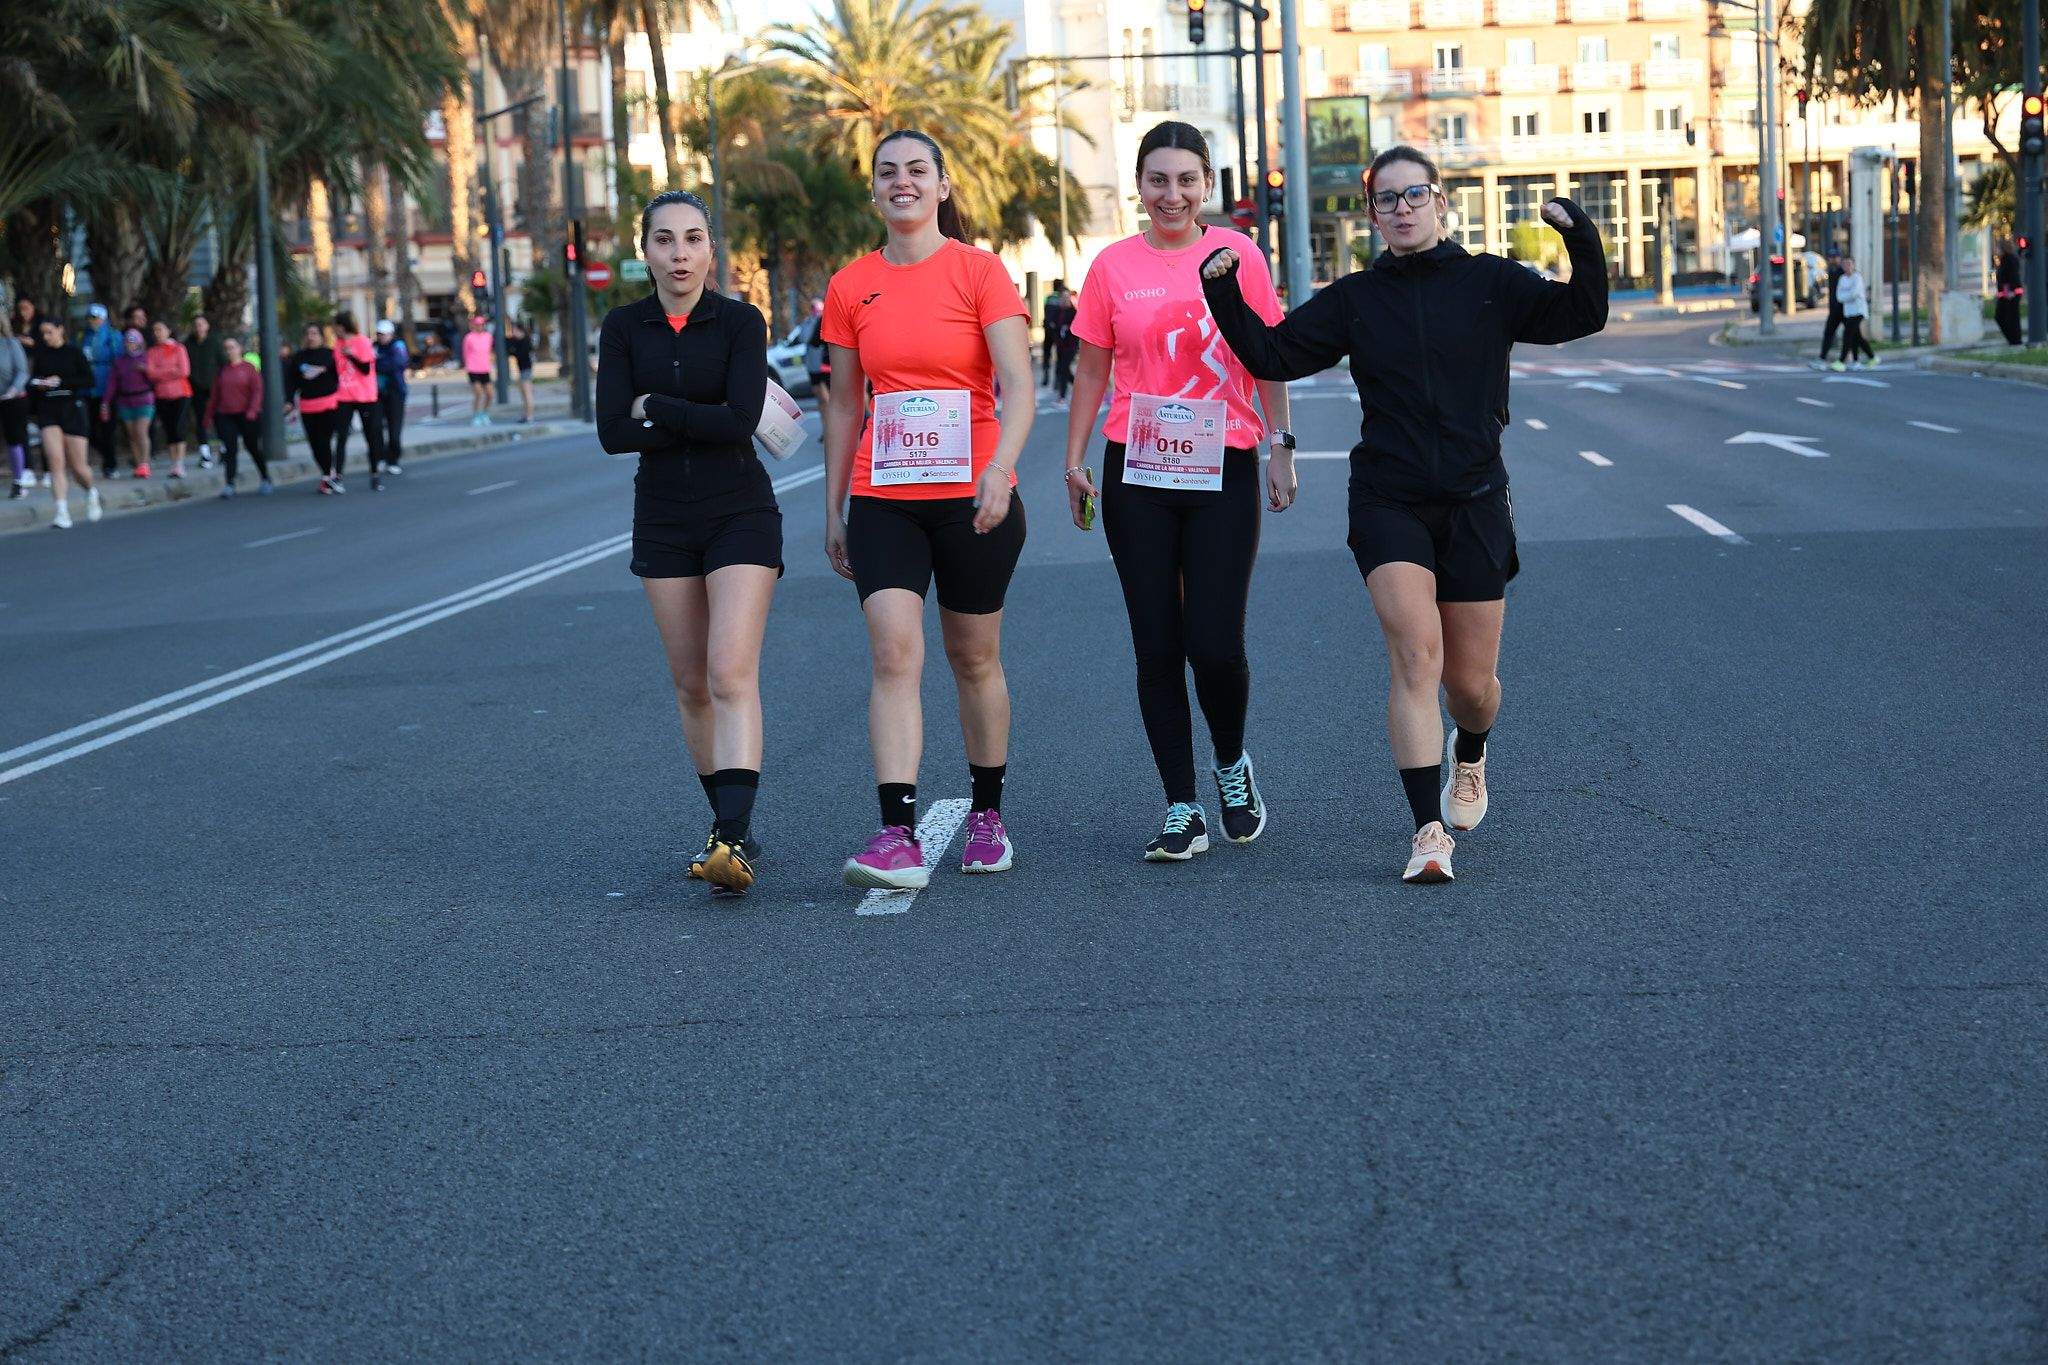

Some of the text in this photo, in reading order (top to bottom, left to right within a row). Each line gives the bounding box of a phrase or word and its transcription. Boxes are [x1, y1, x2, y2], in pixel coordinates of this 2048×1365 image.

[1125, 288, 1166, 301] OYSHO
[902, 405, 936, 413] ASTURIANA
[1159, 411, 1193, 420] ASTURIANA
[902, 432, 939, 447] 016
[1156, 438, 1193, 454] 016
[881, 471, 910, 479] OYSHO
[1133, 473, 1210, 485] OYSHO Santander
